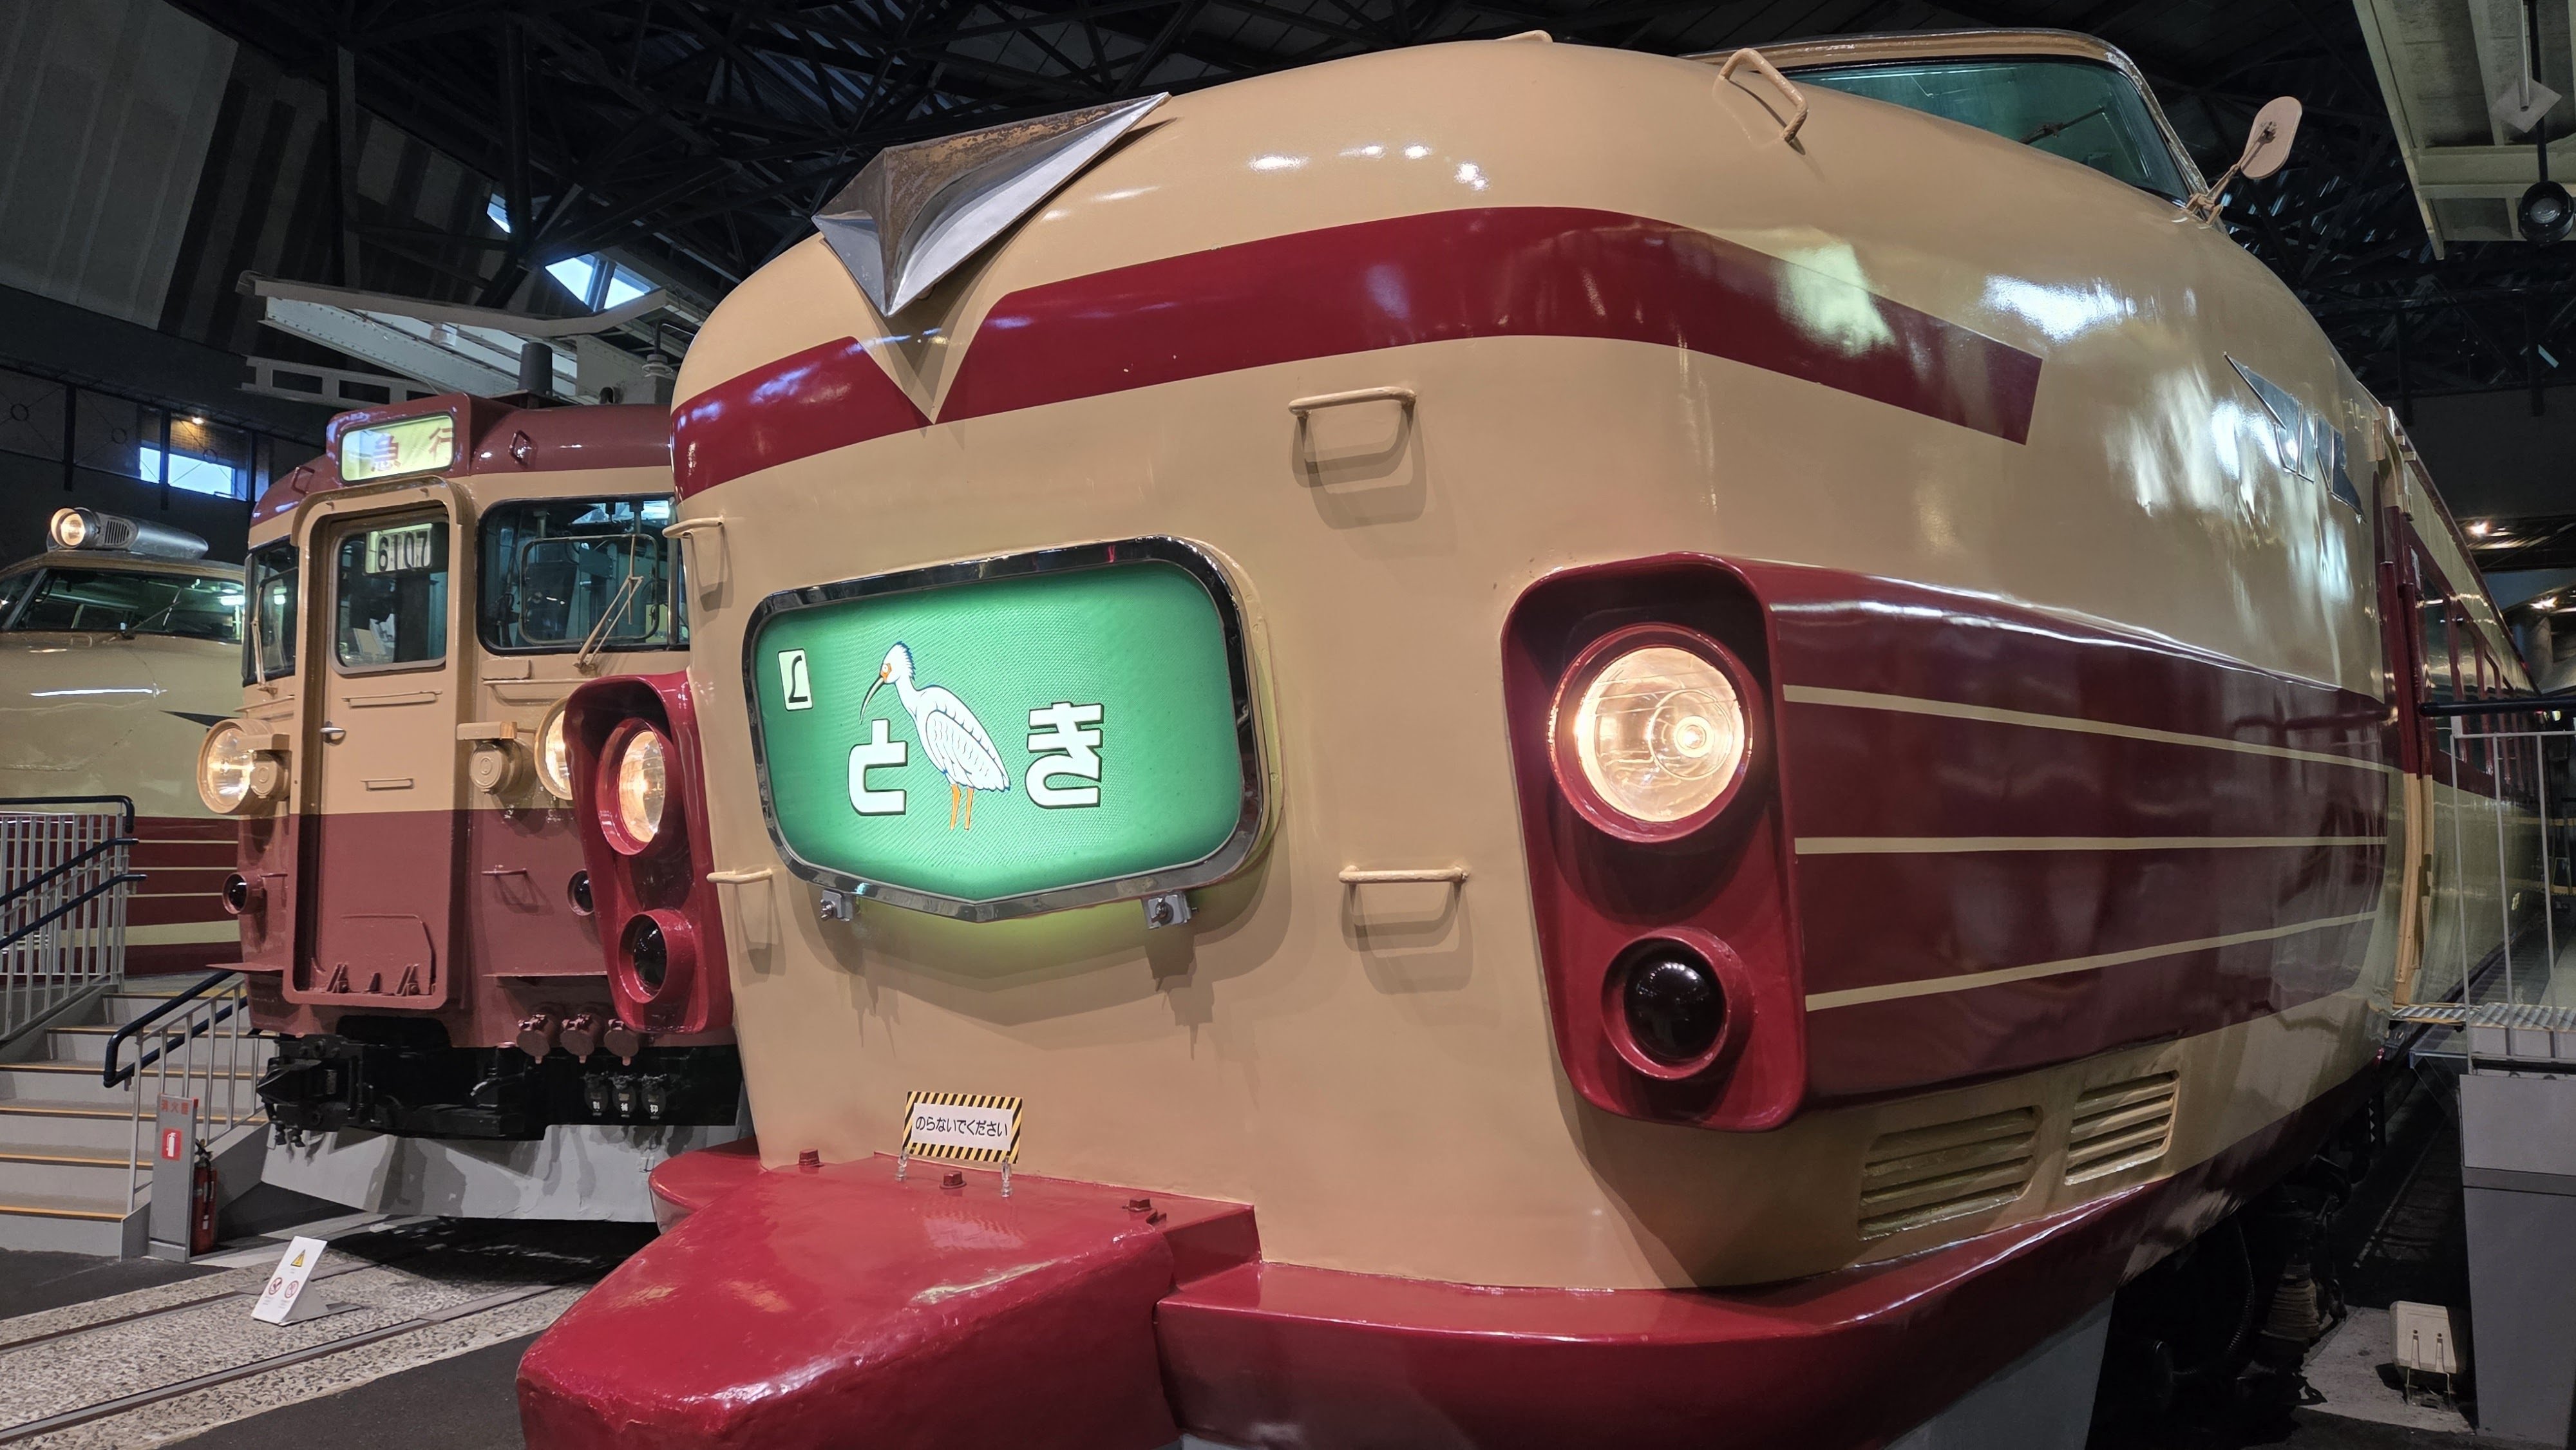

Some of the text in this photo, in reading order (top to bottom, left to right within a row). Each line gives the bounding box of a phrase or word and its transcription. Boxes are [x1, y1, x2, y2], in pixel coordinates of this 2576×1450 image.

[378, 531, 431, 572] 6107
[848, 701, 1104, 816] とき
[915, 1116, 1008, 1137] のらないでください
